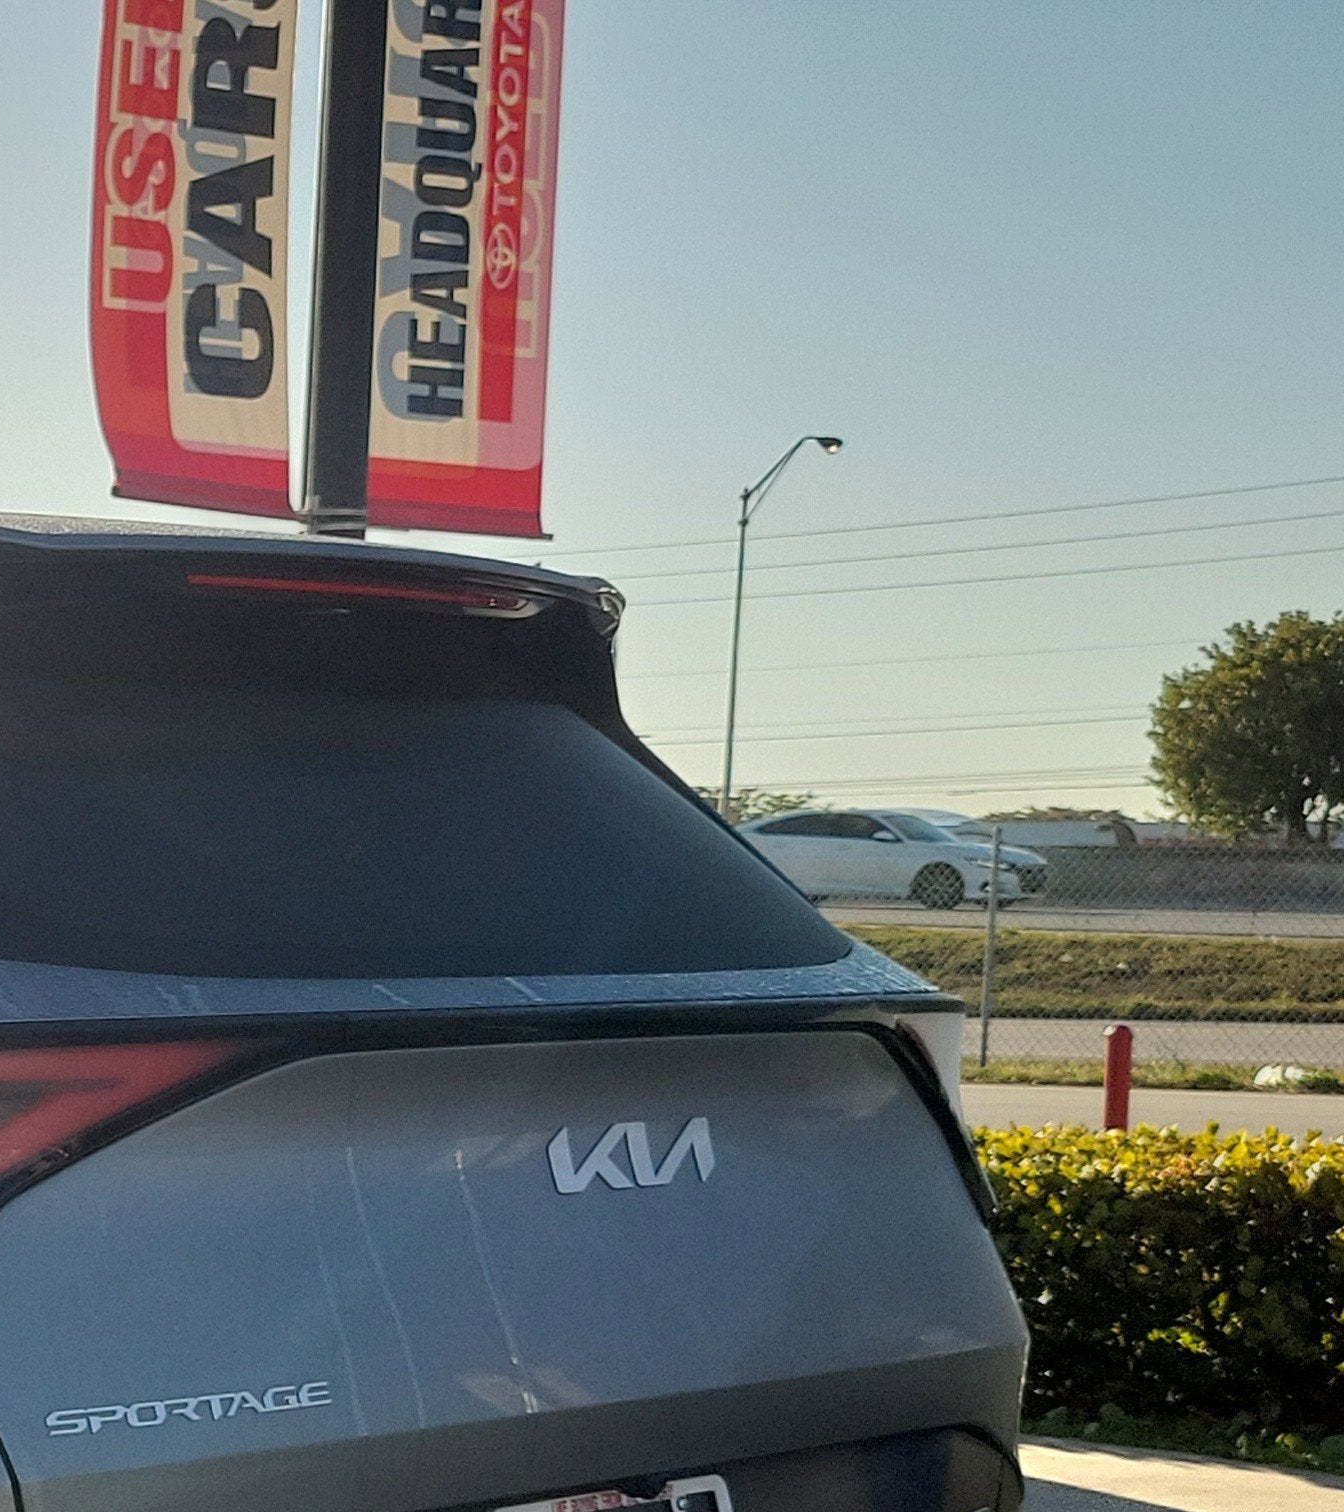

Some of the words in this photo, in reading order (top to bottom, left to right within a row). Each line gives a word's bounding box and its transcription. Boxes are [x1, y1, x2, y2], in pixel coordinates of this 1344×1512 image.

[492, 4, 528, 208] TOYOTA
[183, 0, 282, 399] CAR
[547, 1116, 715, 1194] KIA
[45, 1381, 333, 1436] SPORTAGE
